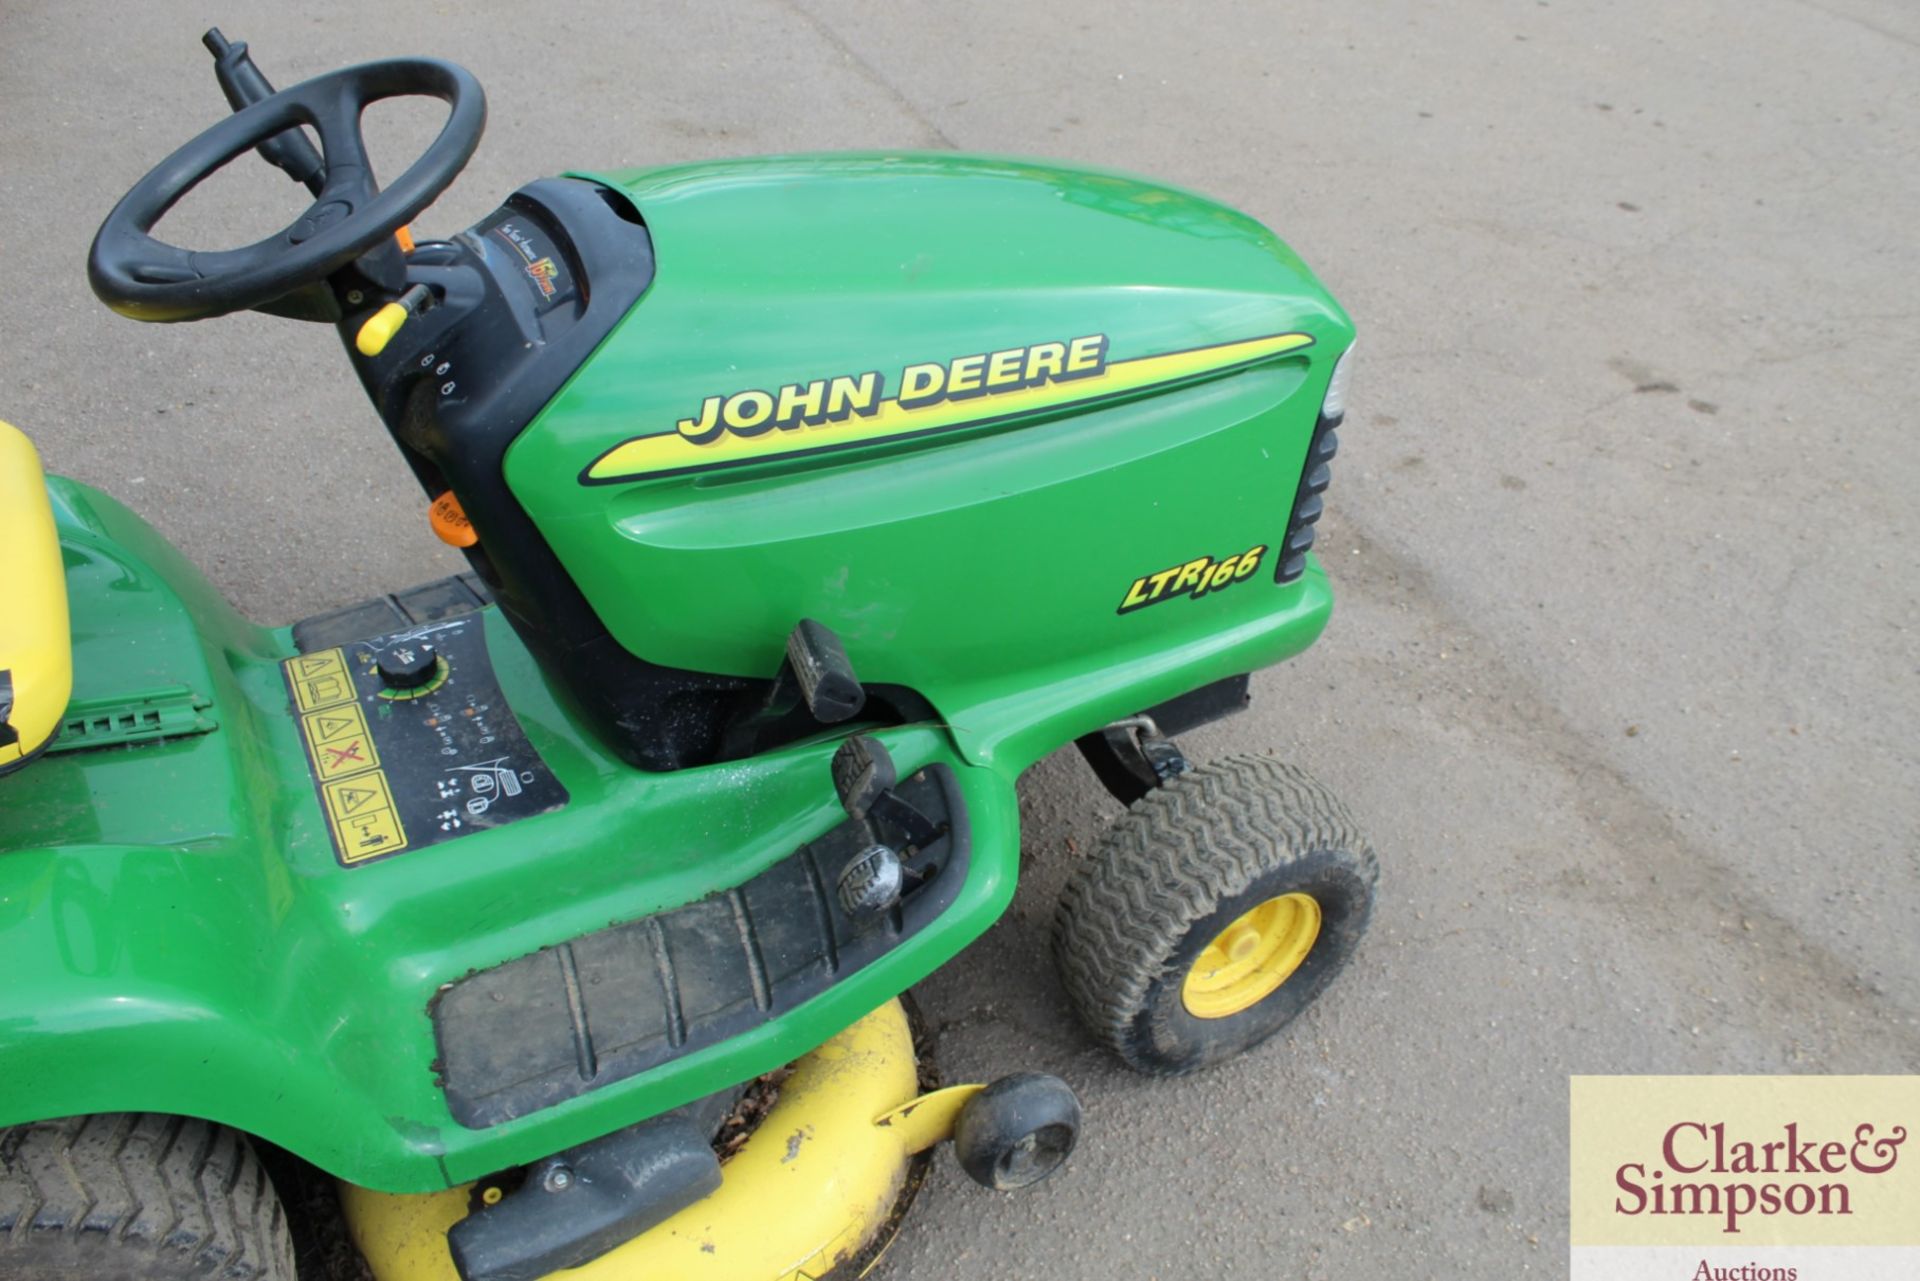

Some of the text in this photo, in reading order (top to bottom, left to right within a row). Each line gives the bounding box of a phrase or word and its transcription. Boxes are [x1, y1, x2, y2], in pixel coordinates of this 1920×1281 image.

[678, 334, 1107, 442] JOHN DEERE
[1119, 545, 1267, 613] LTR166
